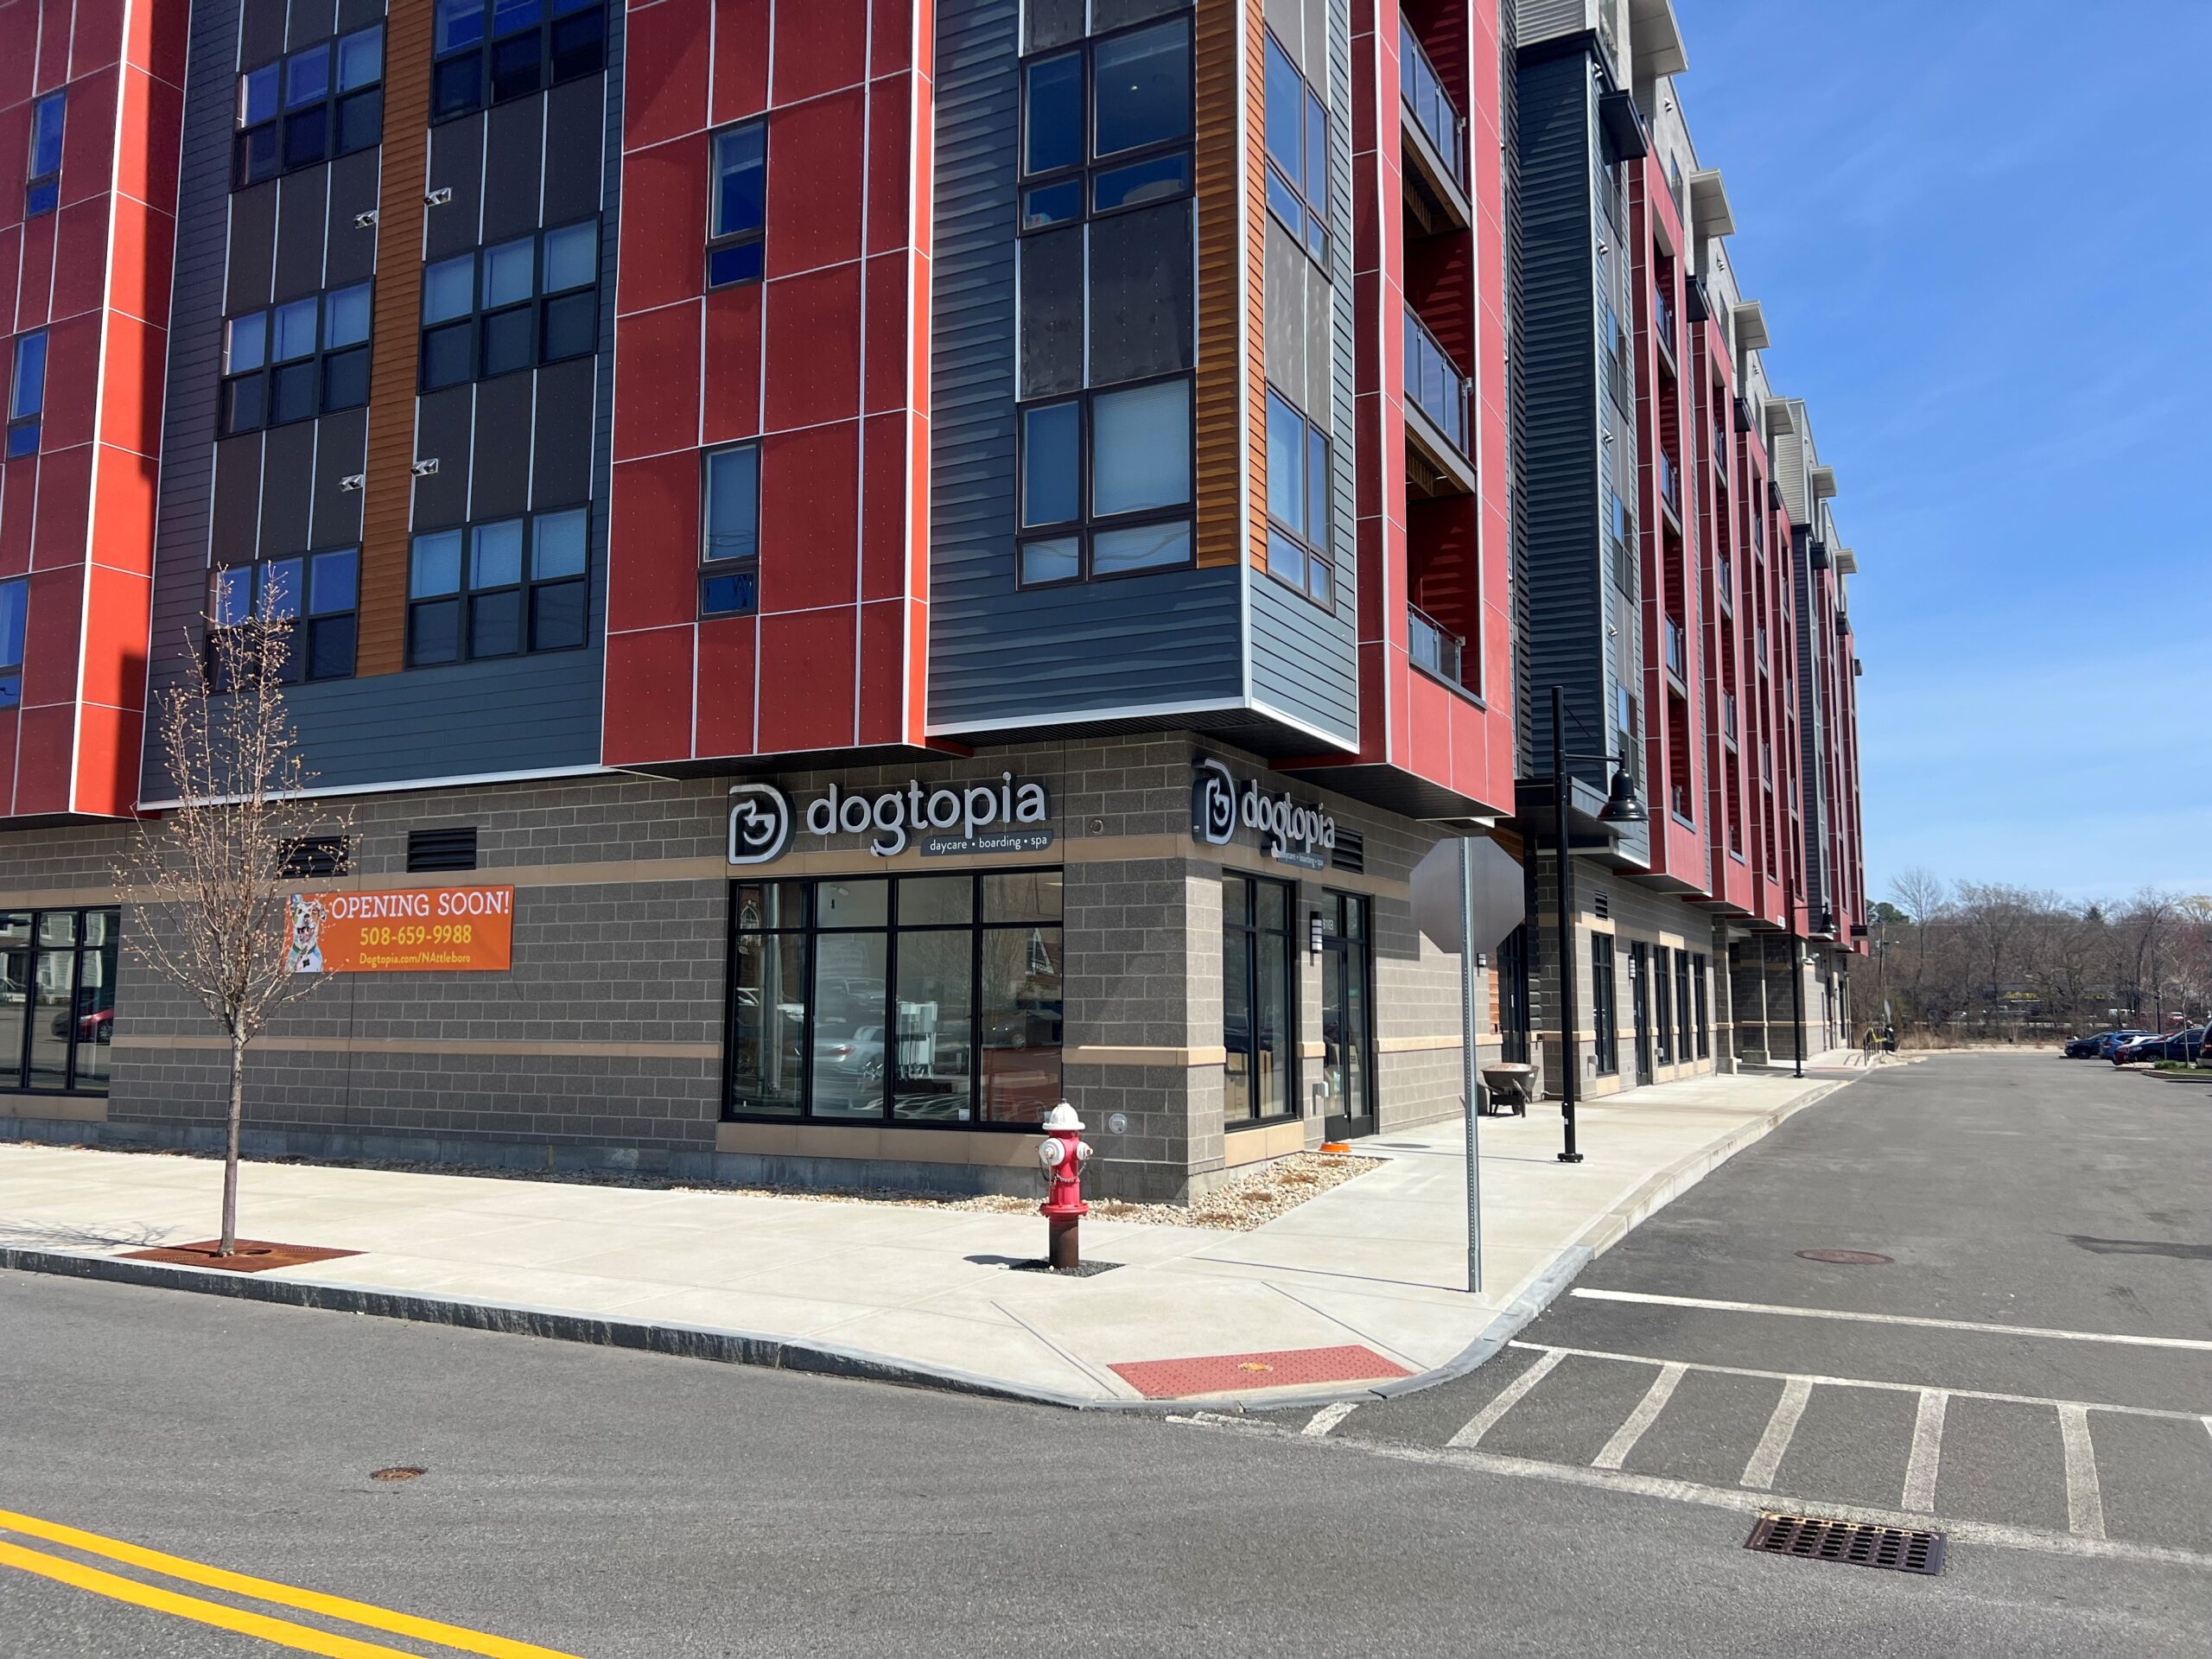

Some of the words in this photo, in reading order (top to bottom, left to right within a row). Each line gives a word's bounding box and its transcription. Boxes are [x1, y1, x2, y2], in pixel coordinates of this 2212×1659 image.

[806, 771, 1046, 857] dogtopia
[1242, 779, 1336, 858] dogtopia
[930, 838, 968, 855] daycare
[978, 835, 1021, 850] boarding
[1030, 836, 1047, 849] spa
[331, 893, 430, 919] OPENING
[437, 891, 510, 916] SOON!
[359, 924, 473, 946] 508-659-9988
[359, 950, 472, 969] Dogtopia.com/NAttleboro
